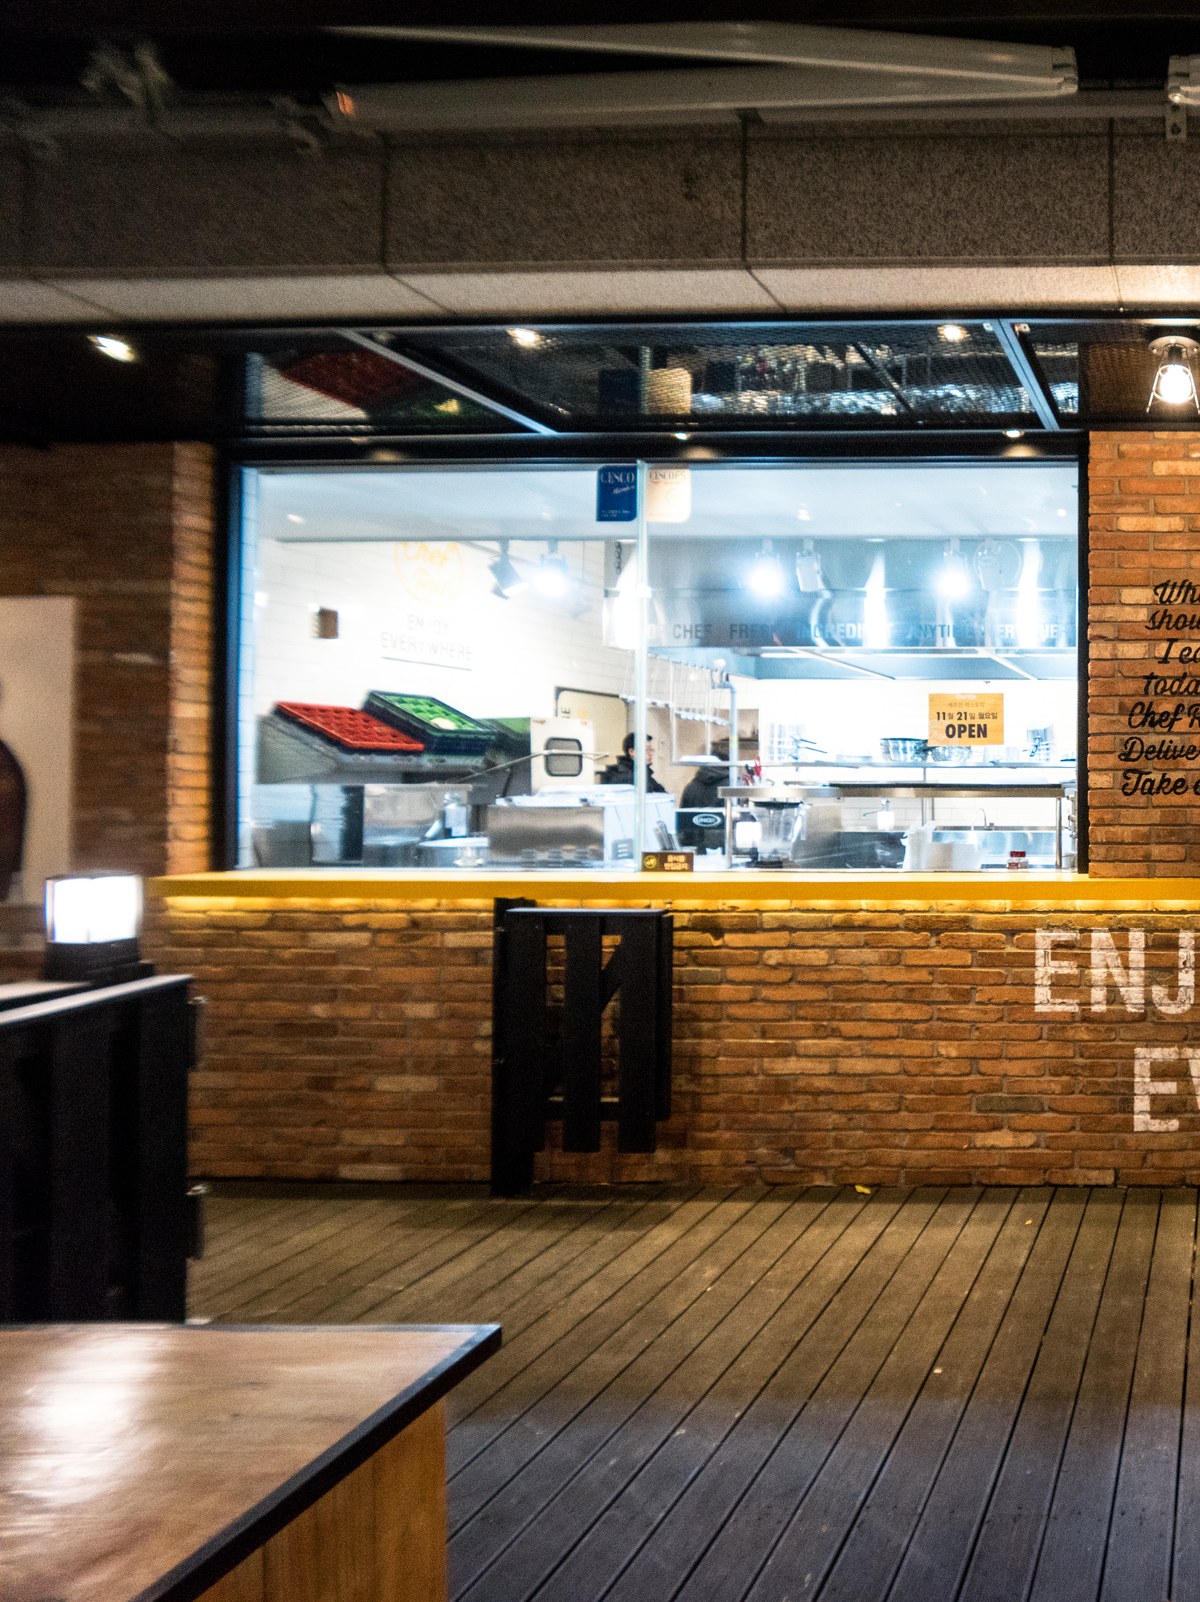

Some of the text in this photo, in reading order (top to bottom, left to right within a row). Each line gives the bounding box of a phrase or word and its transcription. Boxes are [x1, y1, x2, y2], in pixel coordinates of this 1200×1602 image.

[600, 472, 635, 484] CESCO
[407, 614, 452, 636] ENOY
[672, 623, 713, 639] CHEF
[729, 624, 779, 640] FRES
[1157, 638, 1178, 664] I
[936, 711, 954, 720] 11월
[957, 711, 976, 720] 21일
[1128, 702, 1186, 732] Chef
[945, 723, 988, 738] OPEN
[1121, 769, 1189, 797] Take
